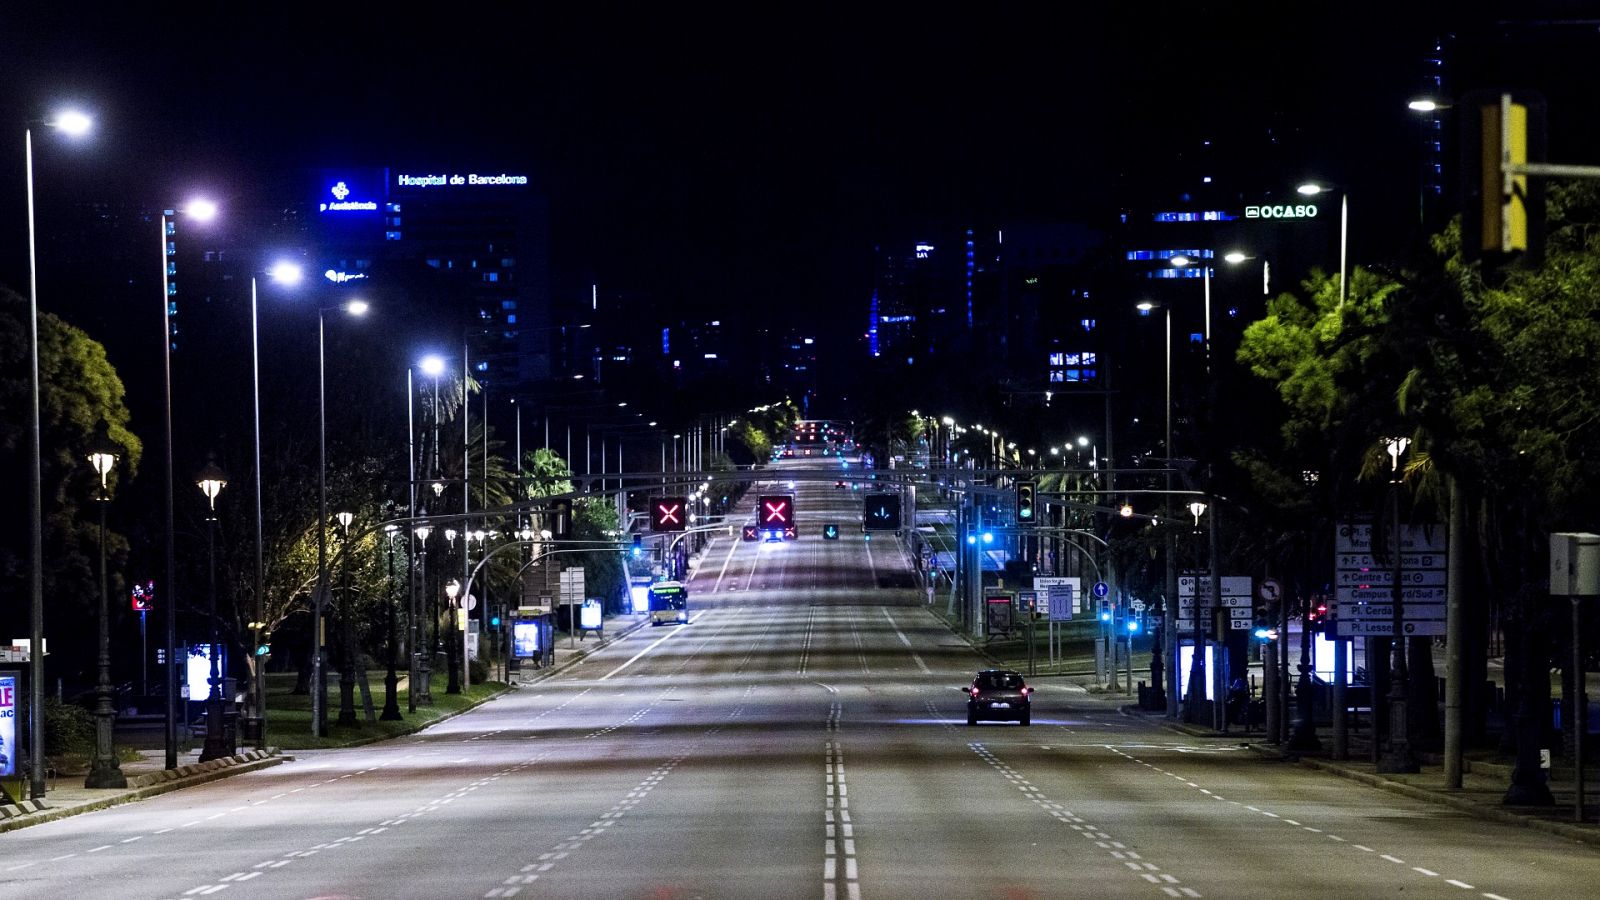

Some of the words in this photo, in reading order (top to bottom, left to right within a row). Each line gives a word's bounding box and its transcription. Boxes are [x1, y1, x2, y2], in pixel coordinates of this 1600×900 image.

[398, 174, 447, 187] Hospital
[450, 174, 466, 185] de
[468, 174, 528, 185] Barcelona
[1260, 204, 1318, 219] OCASO
[1351, 573, 1382, 582] Centre
[1384, 573, 1411, 582] Cat
[1351, 589, 1389, 600] Campus
[1390, 589, 1433, 599] rd/Sud
[1351, 606, 1363, 615] Pl.
[1366, 623, 1395, 634] Lesse
